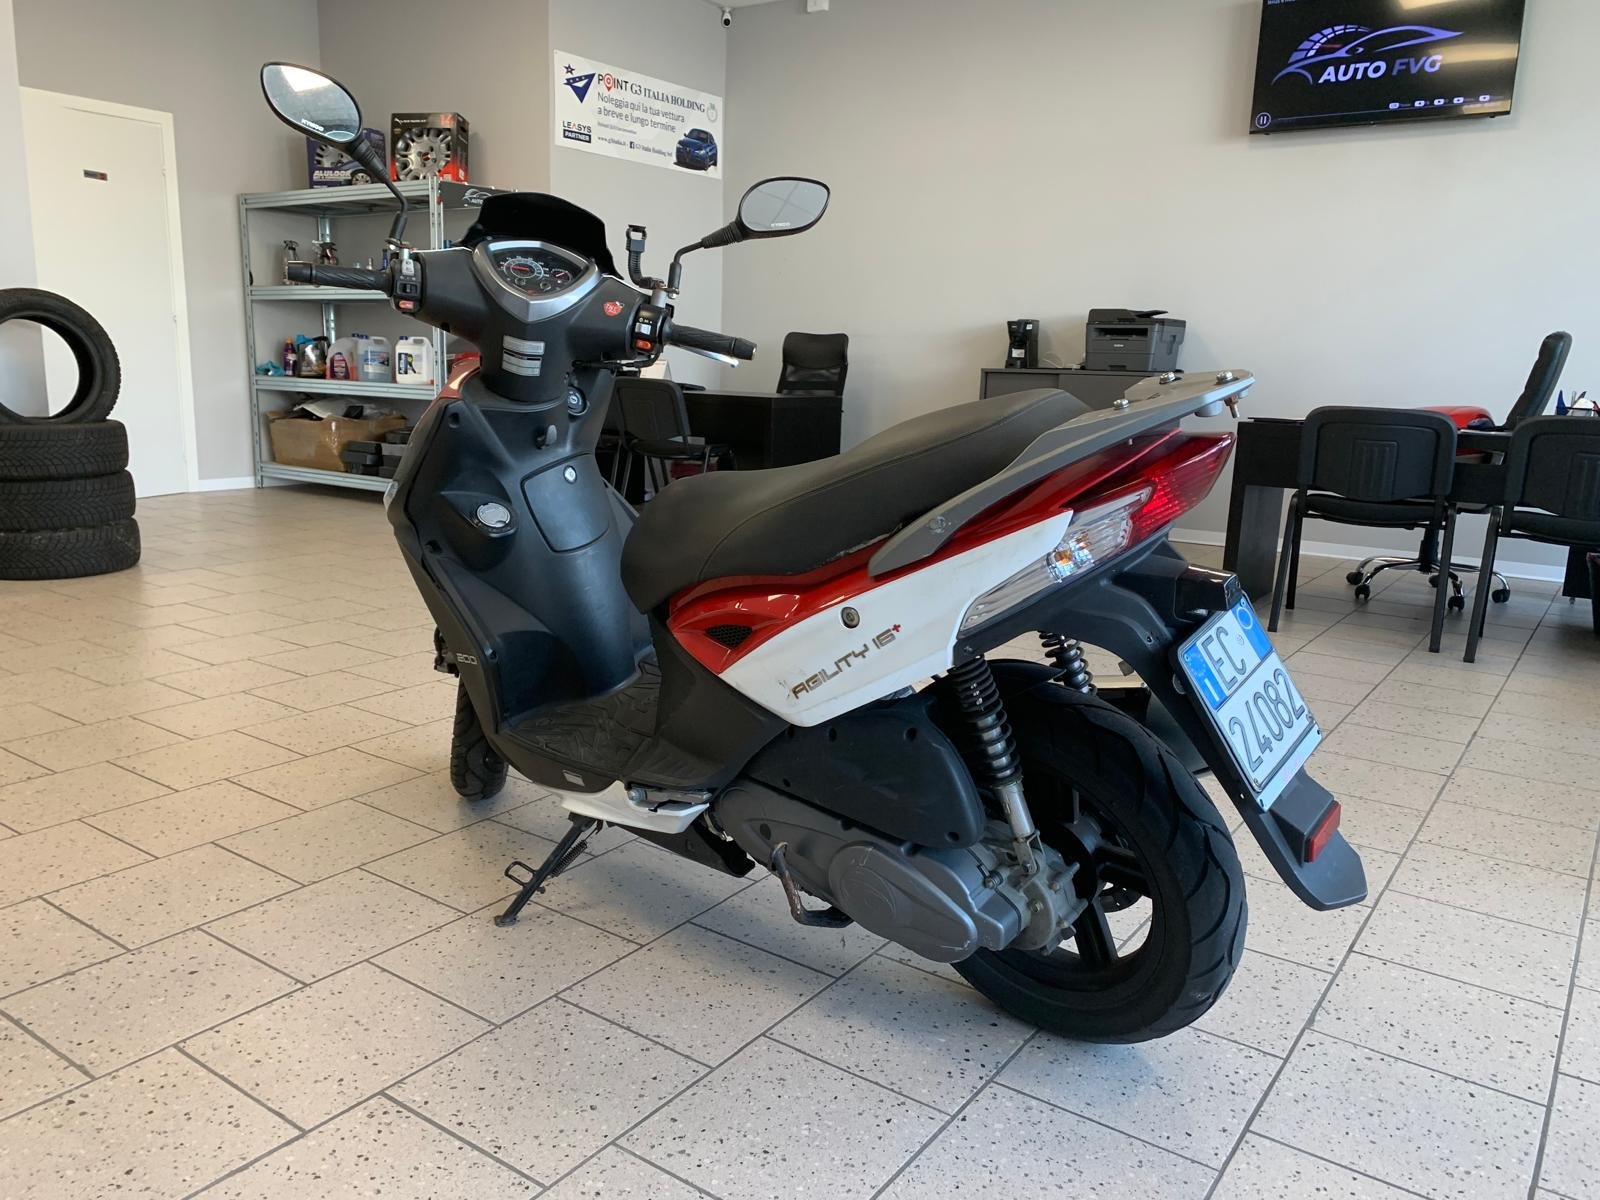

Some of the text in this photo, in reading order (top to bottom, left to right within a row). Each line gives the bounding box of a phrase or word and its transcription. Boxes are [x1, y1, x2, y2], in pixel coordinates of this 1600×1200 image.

[1318, 55, 1442, 84] AUTO FVG
[597, 73, 706, 113] POINT G3 ITALIA HOLDING
[597, 92, 685, 123] Noleggia qui la tua vettura
[562, 120, 592, 134] LEASYS
[597, 106, 603, 115] a
[603, 106, 624, 121] breve
[624, 113, 630, 122] e
[629, 113, 650, 127] lungo
[650, 118, 676, 133] termine
[564, 130, 590, 142] PARTNER
[791, 643, 869, 700] AGILITY
[1201, 626, 1247, 691] EC
[1229, 668, 1305, 773] 24082
